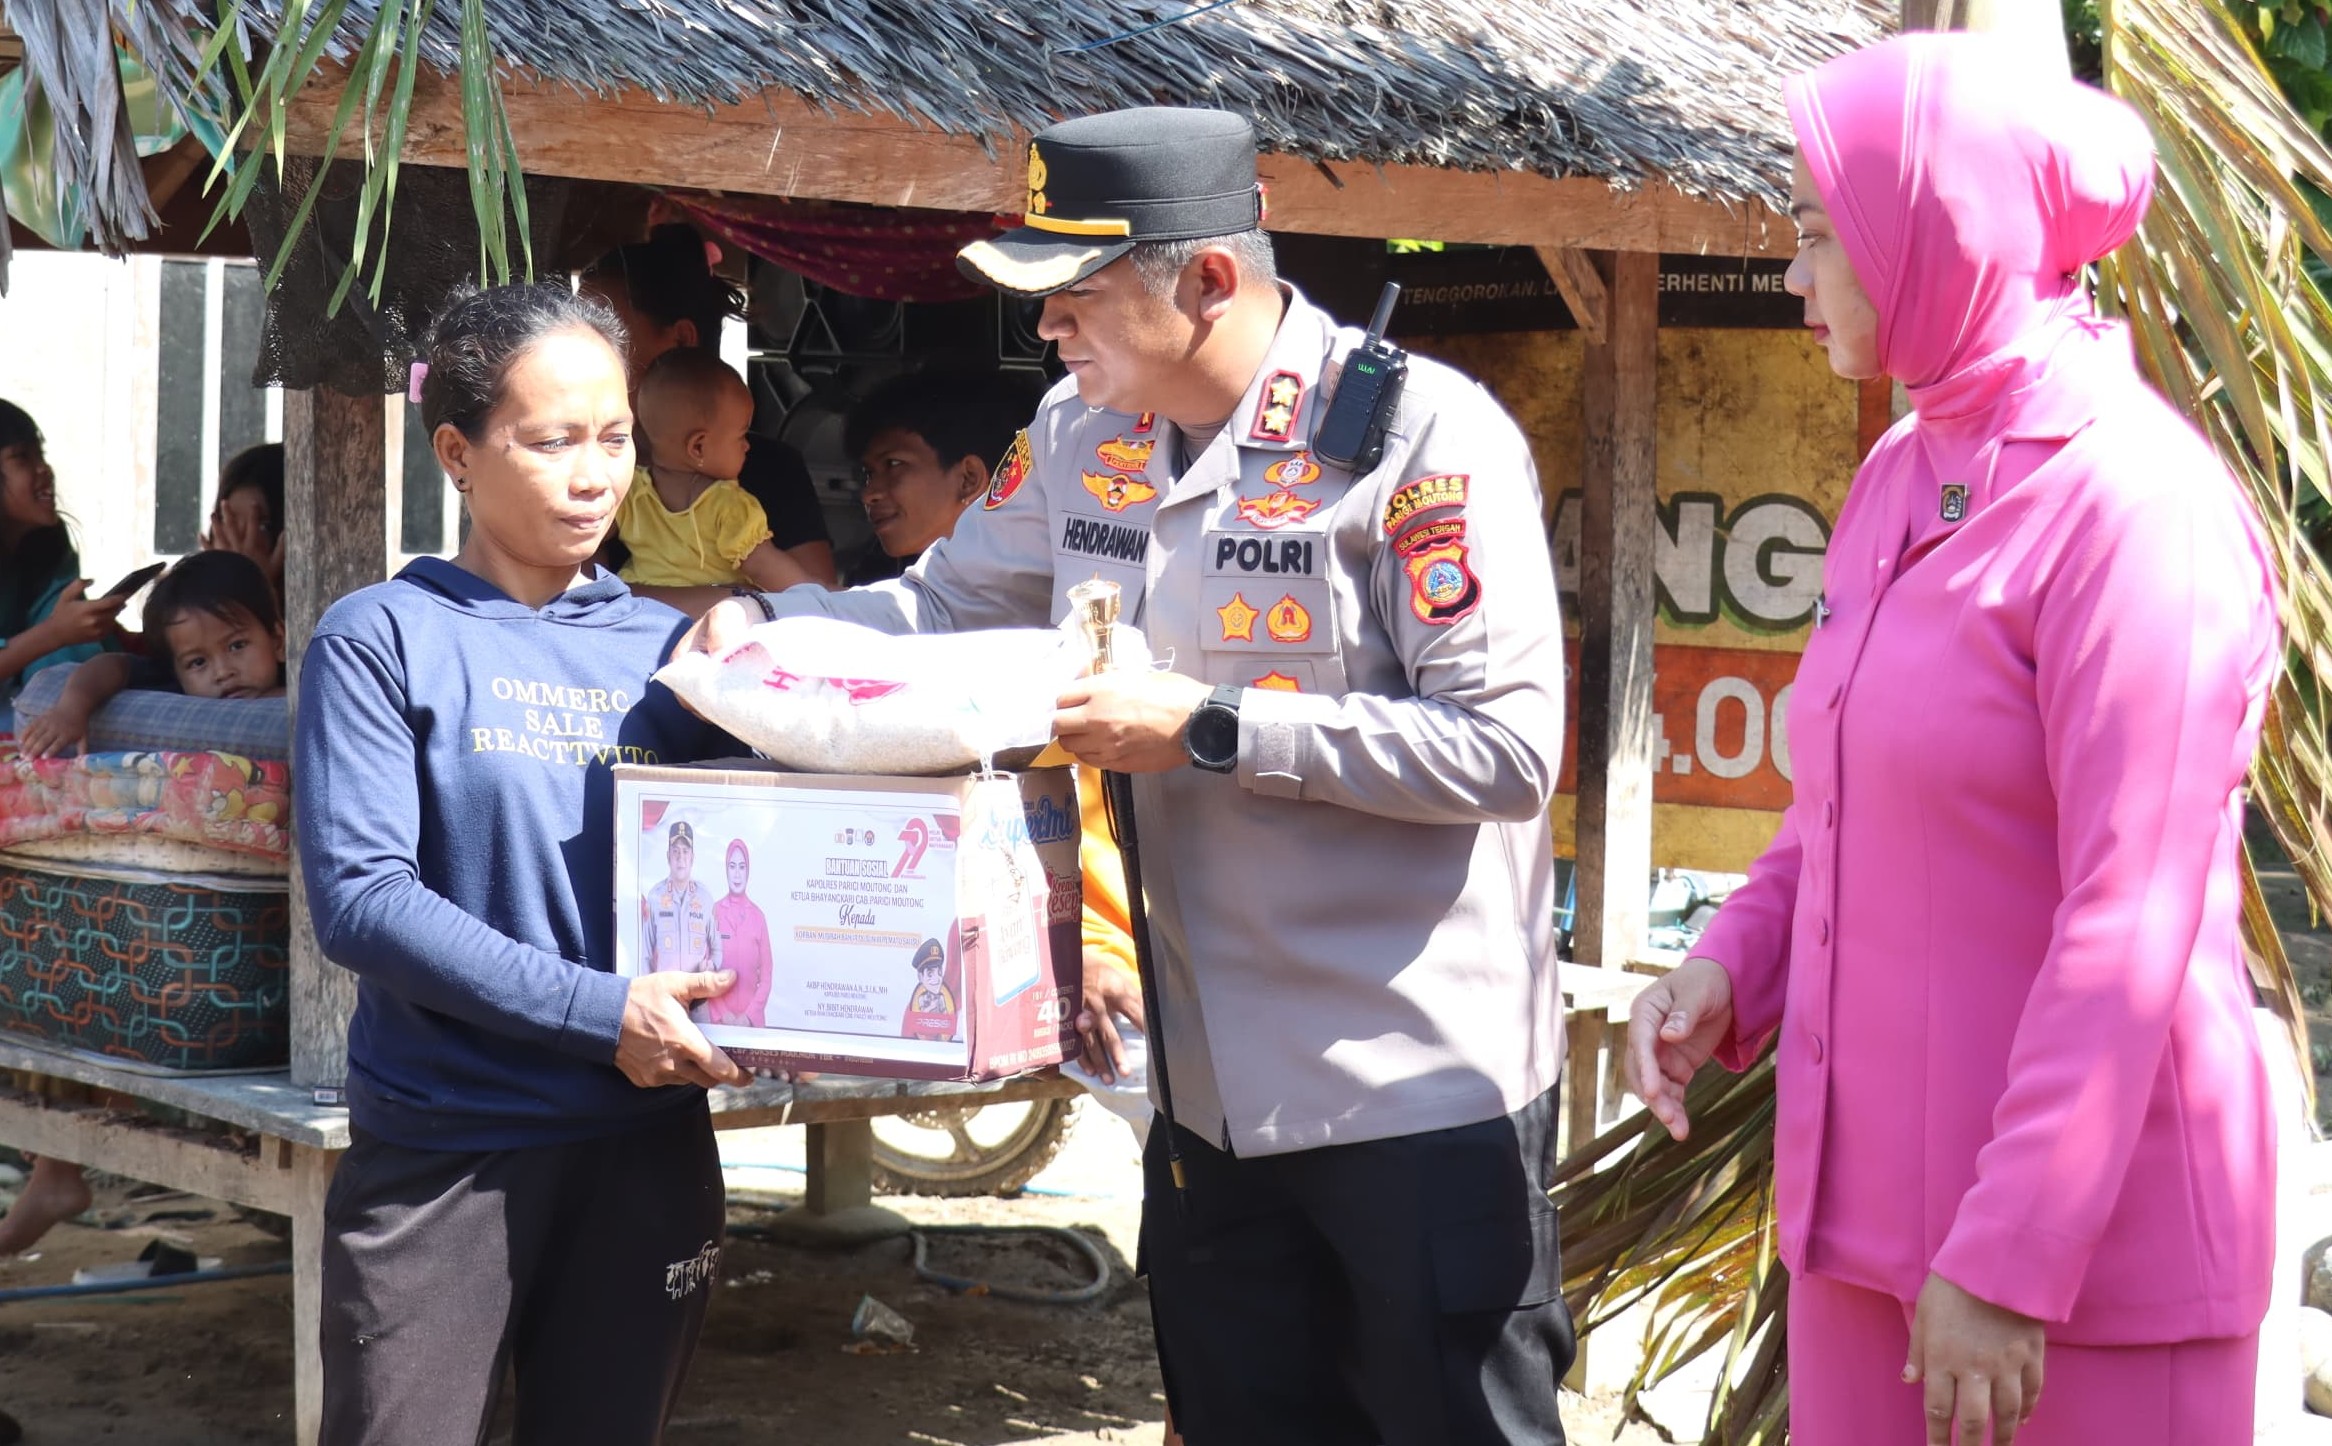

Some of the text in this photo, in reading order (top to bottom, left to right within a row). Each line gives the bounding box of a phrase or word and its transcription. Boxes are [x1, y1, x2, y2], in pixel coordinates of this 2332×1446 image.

[1657, 273, 1784, 292] ERHENTI ME
[1384, 476, 1464, 520] POLRES
[1386, 491, 1464, 530] PARIGI MOUTONG
[1062, 516, 1150, 564] HENDRAWAN
[1398, 523, 1461, 551] SULAWESI TENGAH
[1216, 537, 1312, 575] POLRI
[491, 677, 631, 713] OMMERC
[524, 708, 604, 739] SALE
[825, 857, 860, 877] BANTUAN
[861, 859, 889, 879] SOSIAL
[806, 879, 838, 890] KAPOLRES
[860, 882, 892, 893] MOUTONG
[894, 884, 908, 893] DAN
[839, 904, 876, 928] Kepada
[1036, 997, 1072, 1024] 40
